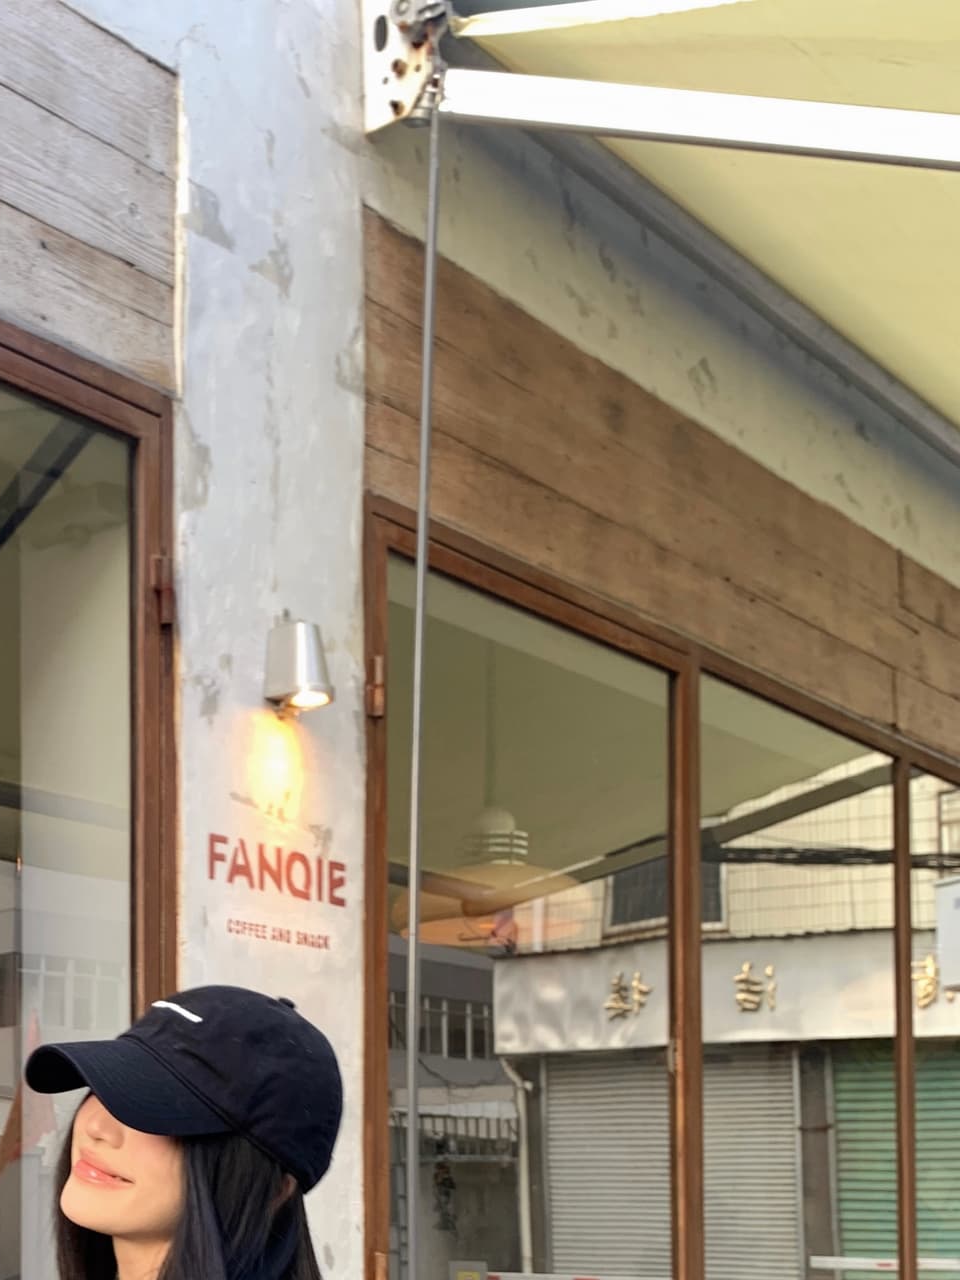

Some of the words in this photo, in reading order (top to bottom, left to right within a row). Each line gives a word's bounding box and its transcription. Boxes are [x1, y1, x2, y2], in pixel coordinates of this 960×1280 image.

[208, 833, 346, 907] FANQIE
[227, 918, 267, 940] COFFEE
[271, 927, 291, 944] AND
